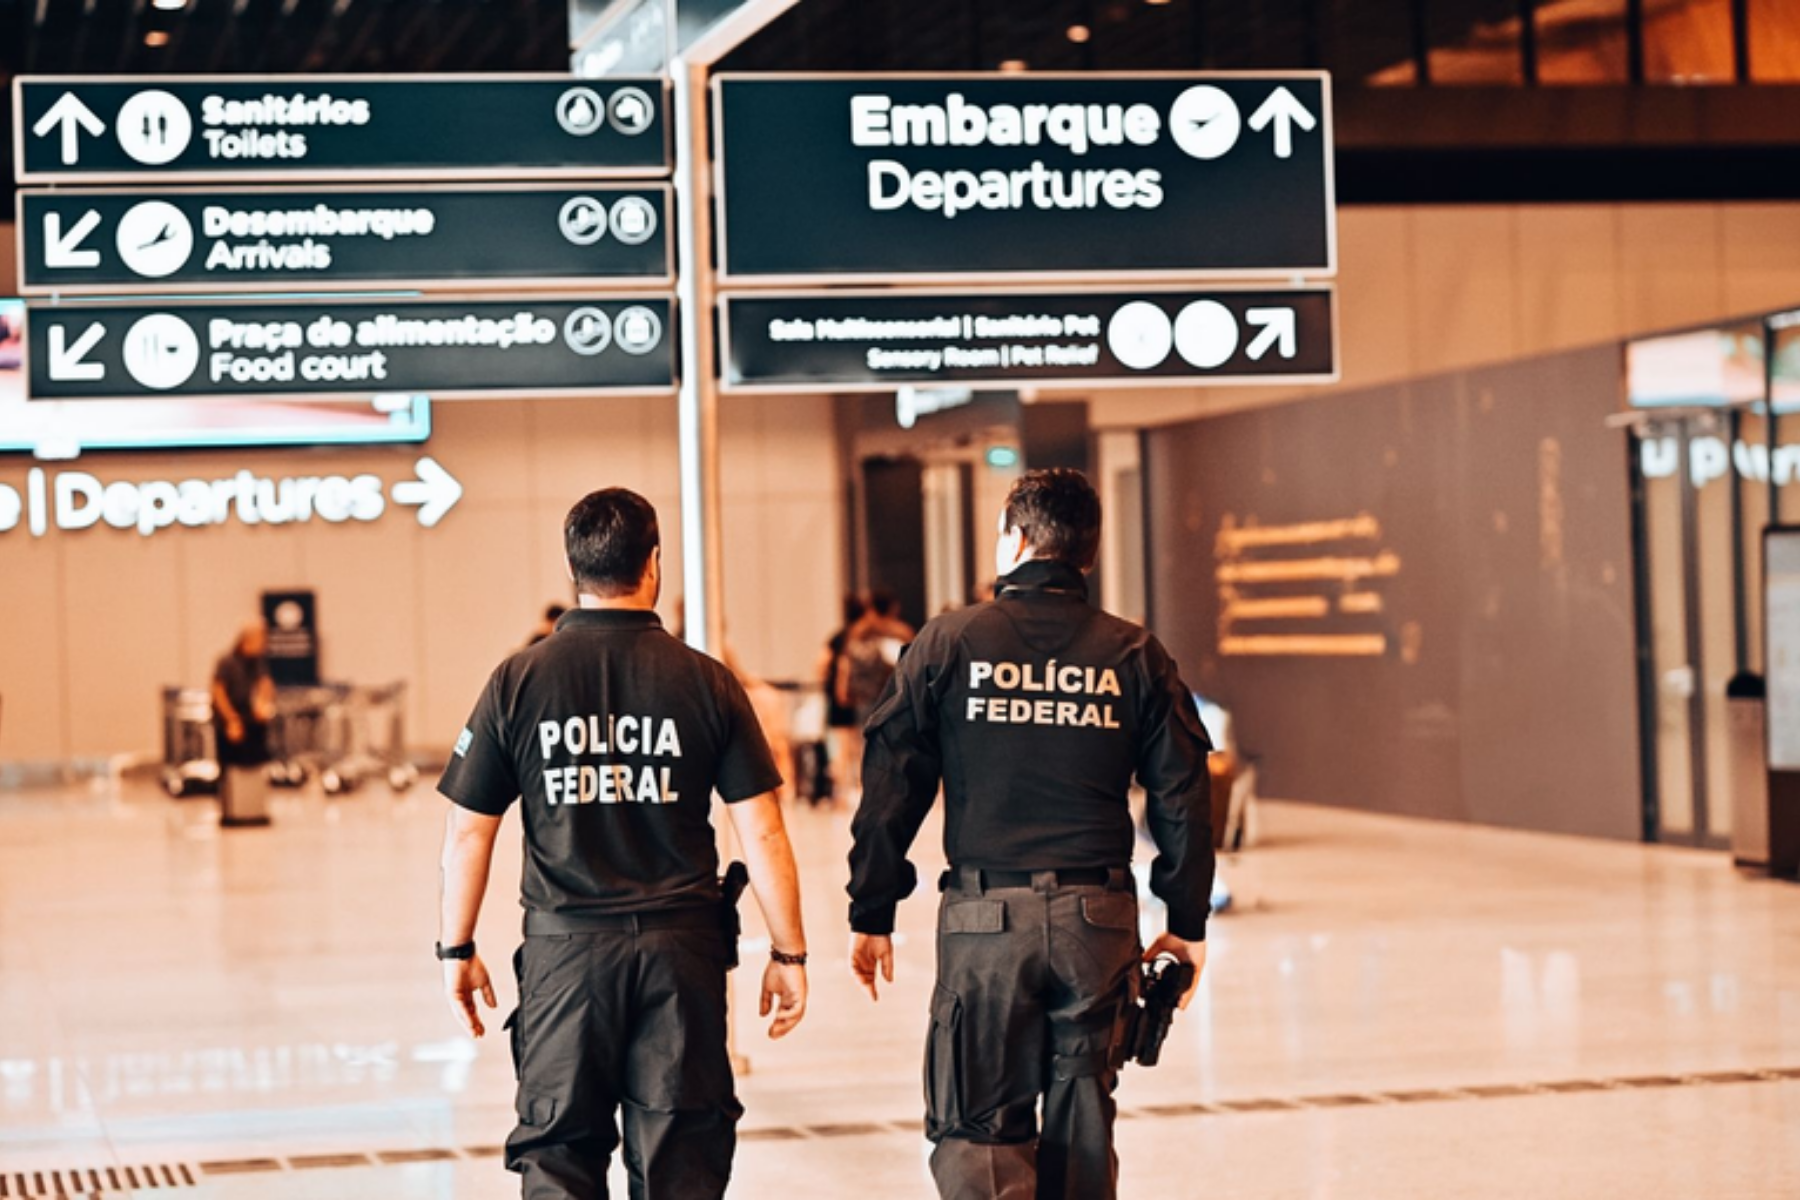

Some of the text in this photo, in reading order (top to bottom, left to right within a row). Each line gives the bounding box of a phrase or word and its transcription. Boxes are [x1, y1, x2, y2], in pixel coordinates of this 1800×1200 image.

[202, 93, 370, 126] Sanitários
[850, 93, 1161, 154] Embarque
[203, 128, 308, 159] Toilets
[868, 160, 1163, 218] Departures
[202, 203, 435, 241] Desembarque
[205, 237, 331, 270] Arrivals
[208, 312, 557, 352] Praça de alimentação
[210, 350, 387, 382] Food court
[54, 469, 387, 537] Departures
[969, 659, 1122, 696] POLÍCIA
[966, 697, 1121, 729] FEDERAL
[543, 764, 679, 805] FEDERAL
